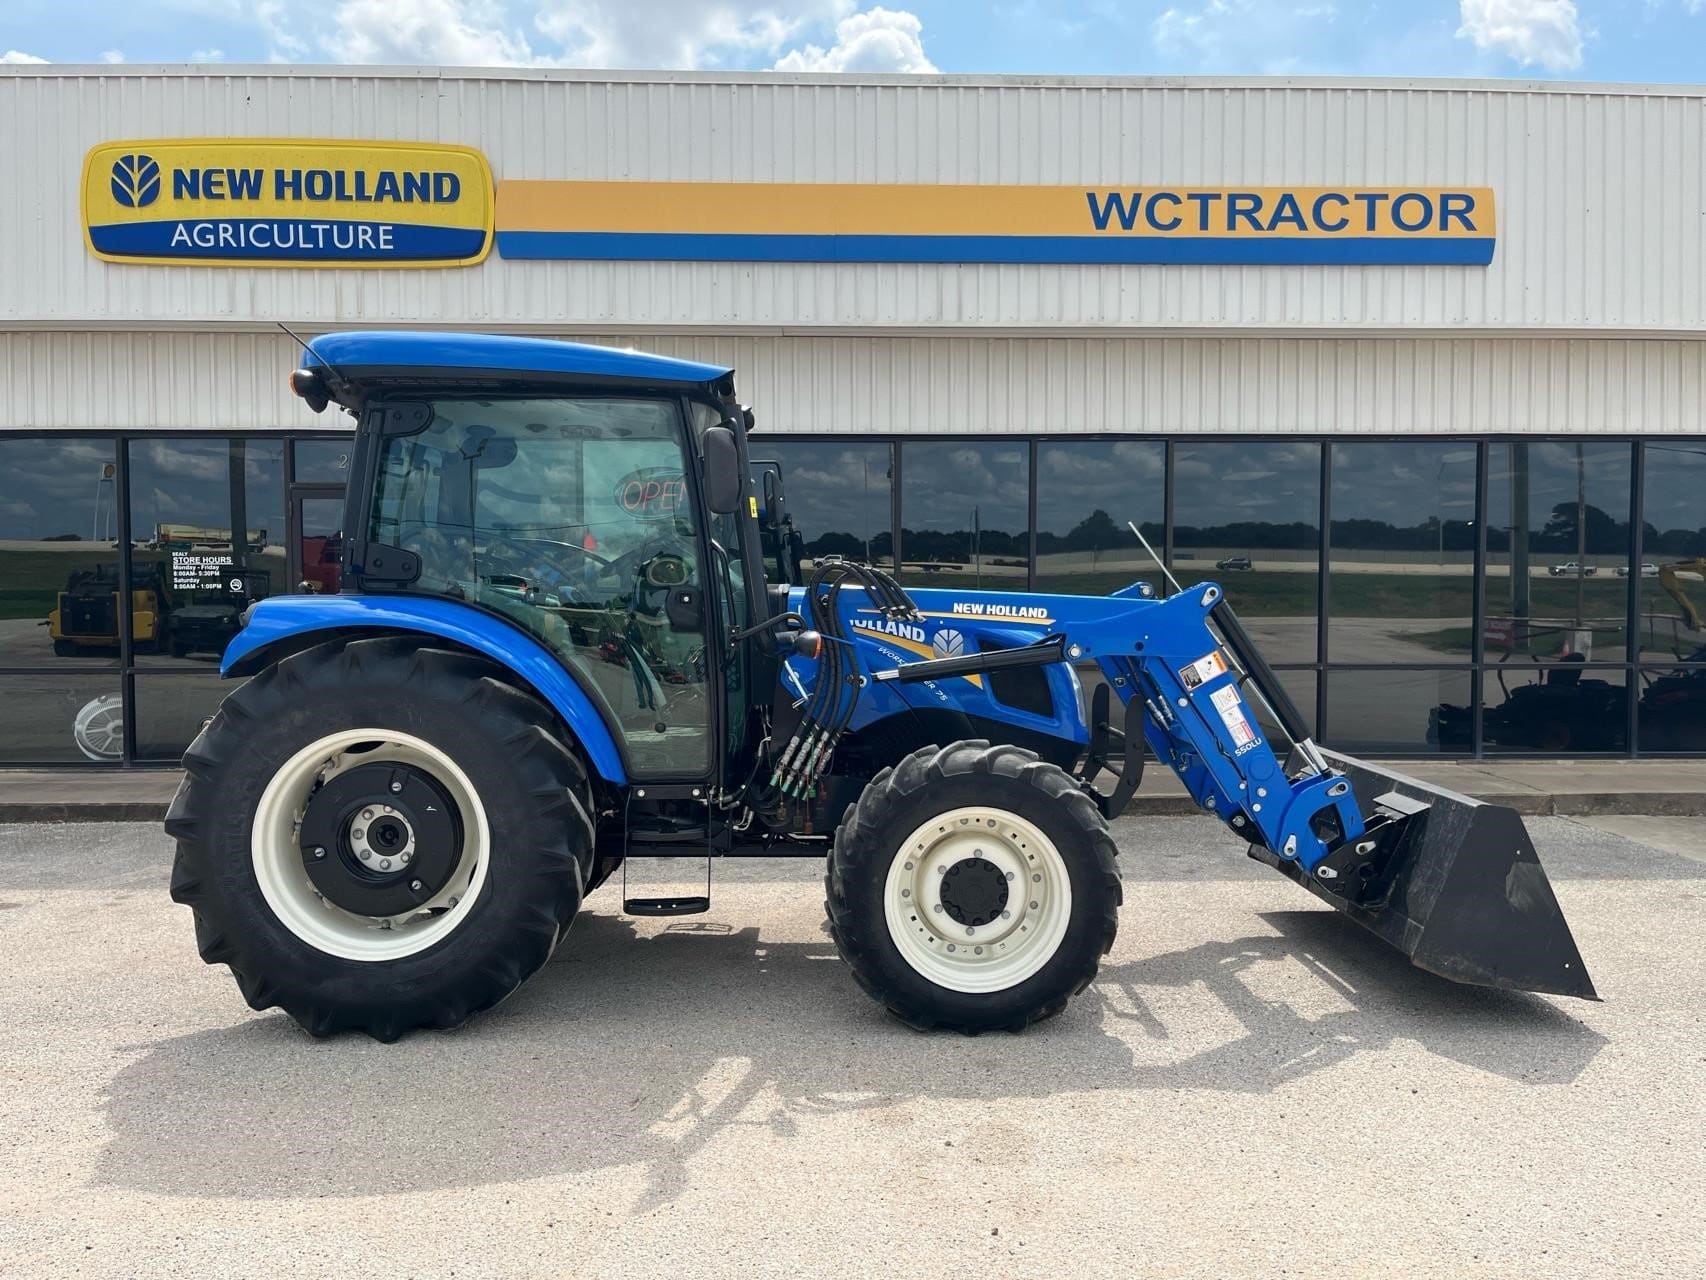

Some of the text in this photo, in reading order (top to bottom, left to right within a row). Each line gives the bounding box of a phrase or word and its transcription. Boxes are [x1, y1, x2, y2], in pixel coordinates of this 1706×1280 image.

[173, 168, 461, 202] NEW HOLLAND
[1086, 192, 1477, 231] WCTRACTOR
[171, 222, 393, 250] AGRICULTURE
[173, 556, 232, 564] STORE HOURS
[953, 602, 1048, 619] NEW HOLLAND
[849, 620, 926, 642] OLLAND
[935, 690, 949, 701] 75
